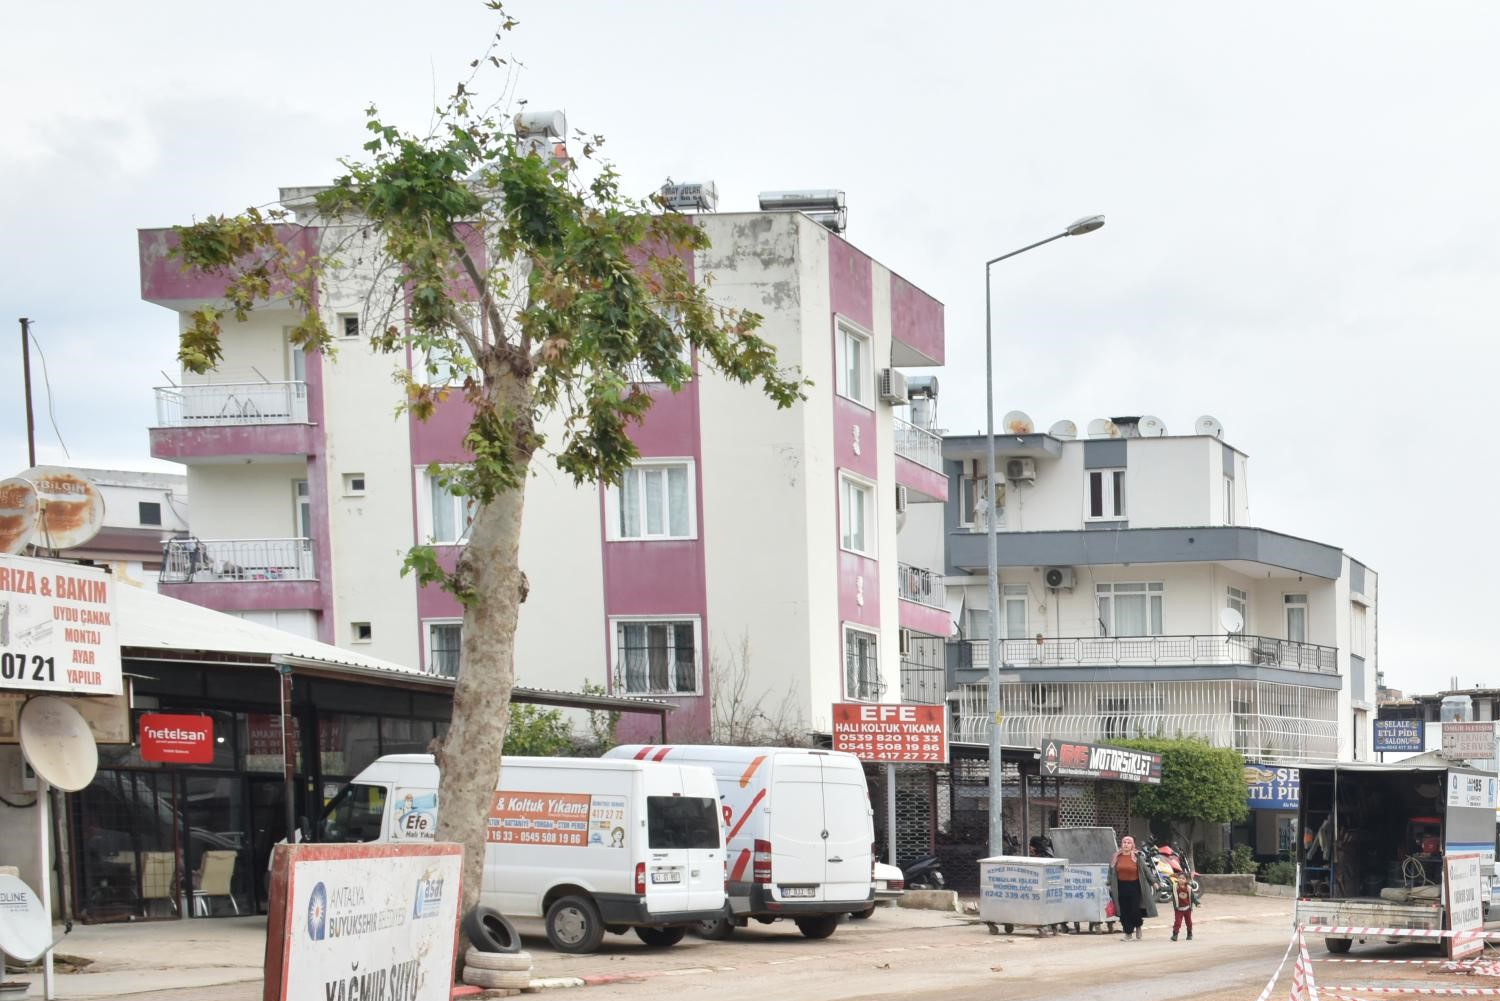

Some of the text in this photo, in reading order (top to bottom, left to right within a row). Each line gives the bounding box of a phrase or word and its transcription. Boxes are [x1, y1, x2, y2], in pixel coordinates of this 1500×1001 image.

[0, 566, 107, 604] RIZA & BAKIM
[53, 606, 112, 627] UYDU ÇANAK
[64, 628, 101, 645] MONTAJ
[72, 650, 95, 665] AYAR
[32, 655, 55, 682] 21
[66, 669, 102, 686] YAPILIR
[860, 706, 917, 722] EFE
[835, 723, 942, 733] HALI KOLTUK YIKAMA
[1378, 728, 1418, 737] ETLİ PİDE
[1384, 720, 1410, 730] ŞELALE
[147, 727, 206, 742] netelsan
[876, 734, 902, 742] 820
[1385, 737, 1410, 745] SALONU
[839, 742, 873, 750] 0545
[876, 743, 902, 751] 508
[905, 743, 919, 751] 19
[878, 752, 900, 760] 417
[508, 798, 544, 813] Koltuk
[547, 799, 589, 815] Yıkama
[405, 815, 427, 830] Efe
[520, 831, 540, 843] 0545
[329, 886, 365, 909] ANTALYA
[328, 907, 378, 939] BÜYÜKŞEHİR
